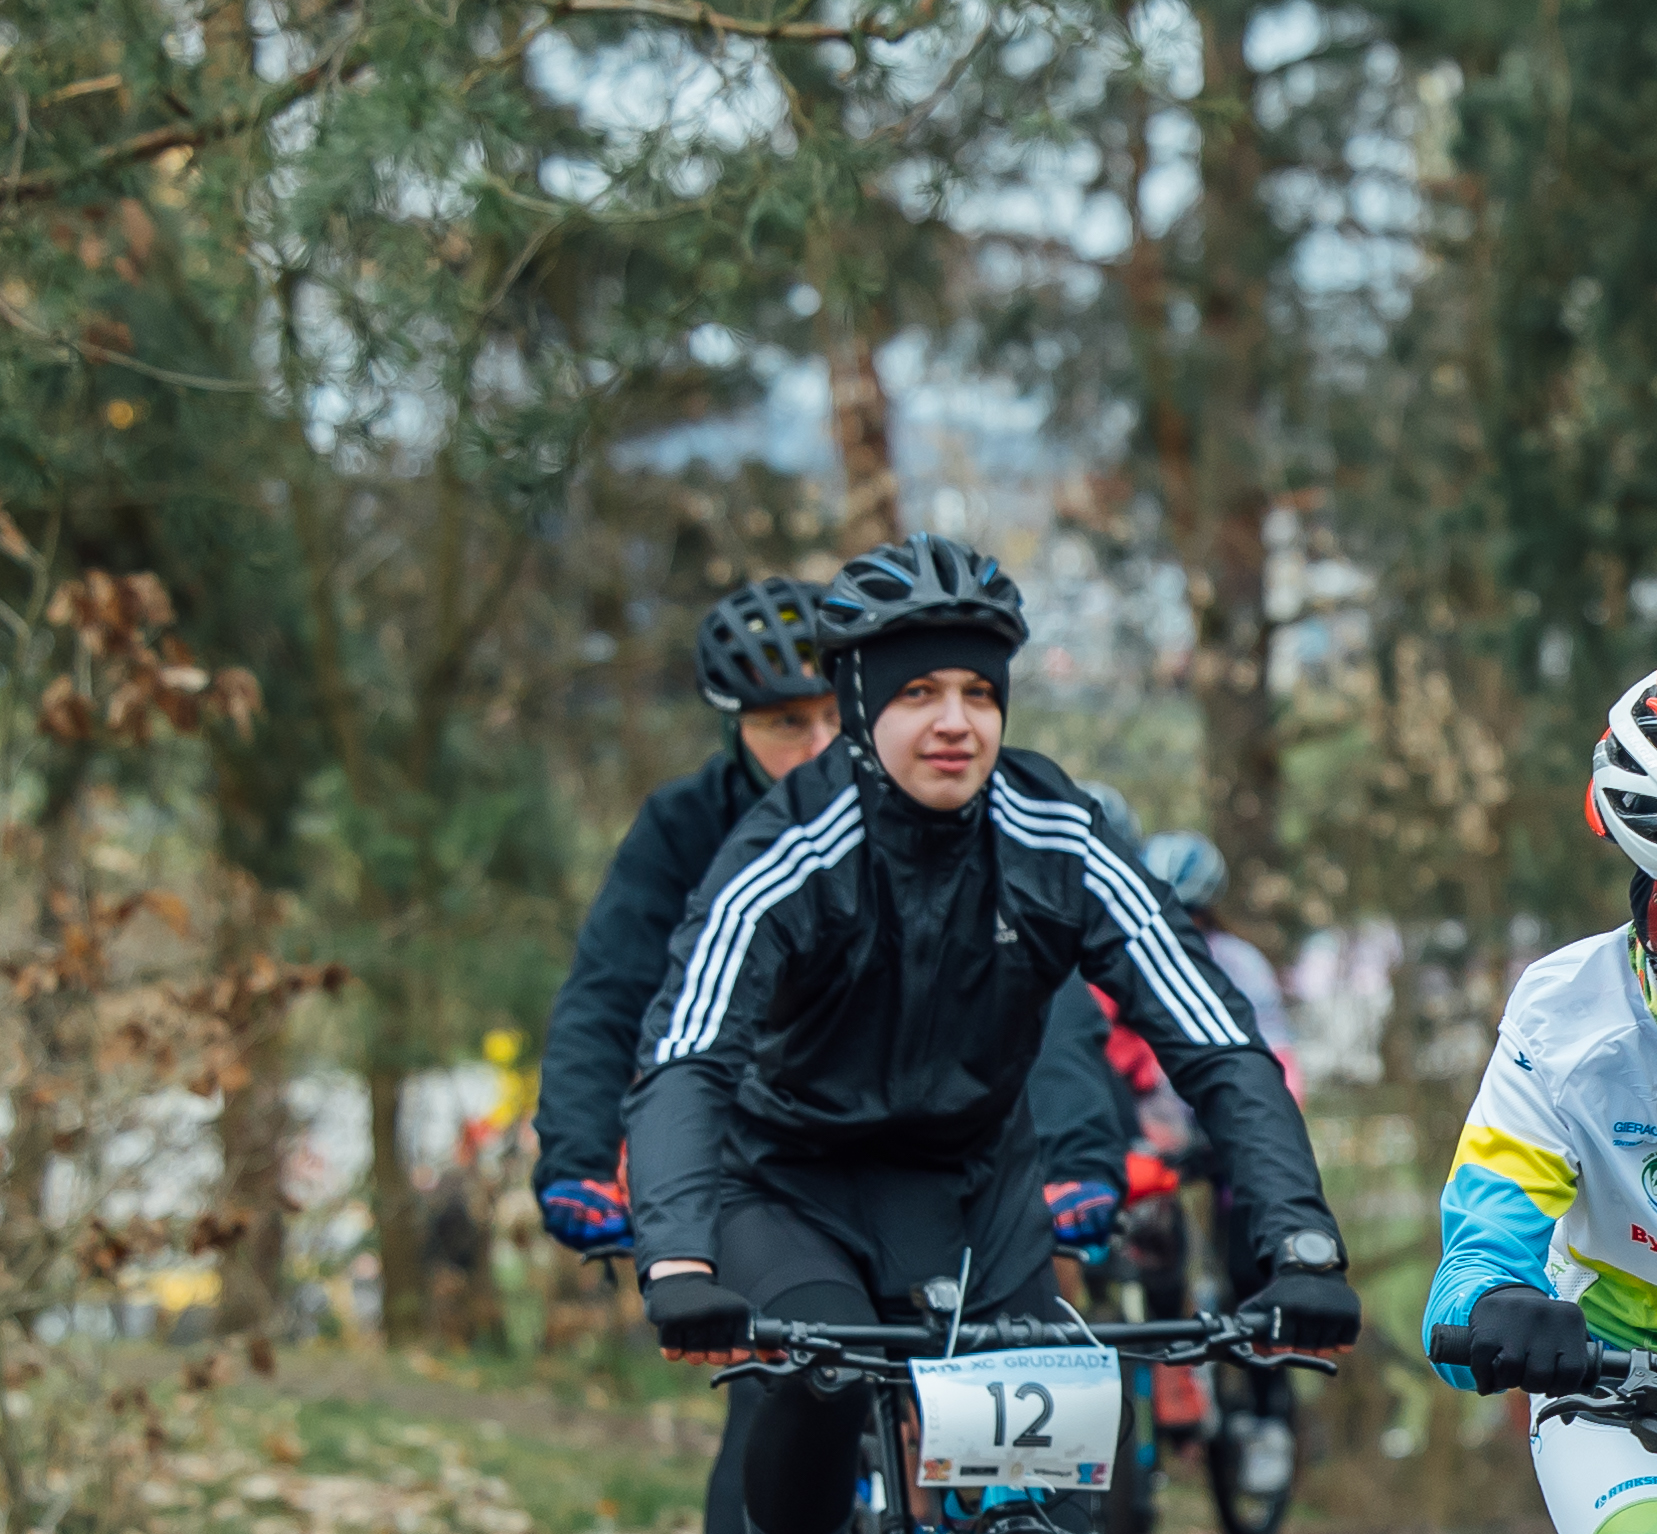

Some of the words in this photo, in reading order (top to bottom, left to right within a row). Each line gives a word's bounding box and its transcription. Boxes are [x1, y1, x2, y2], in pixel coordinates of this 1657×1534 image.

[919, 1362, 962, 1375] MTB
[972, 1358, 996, 1369] XC
[986, 1381, 1055, 1447] 12
